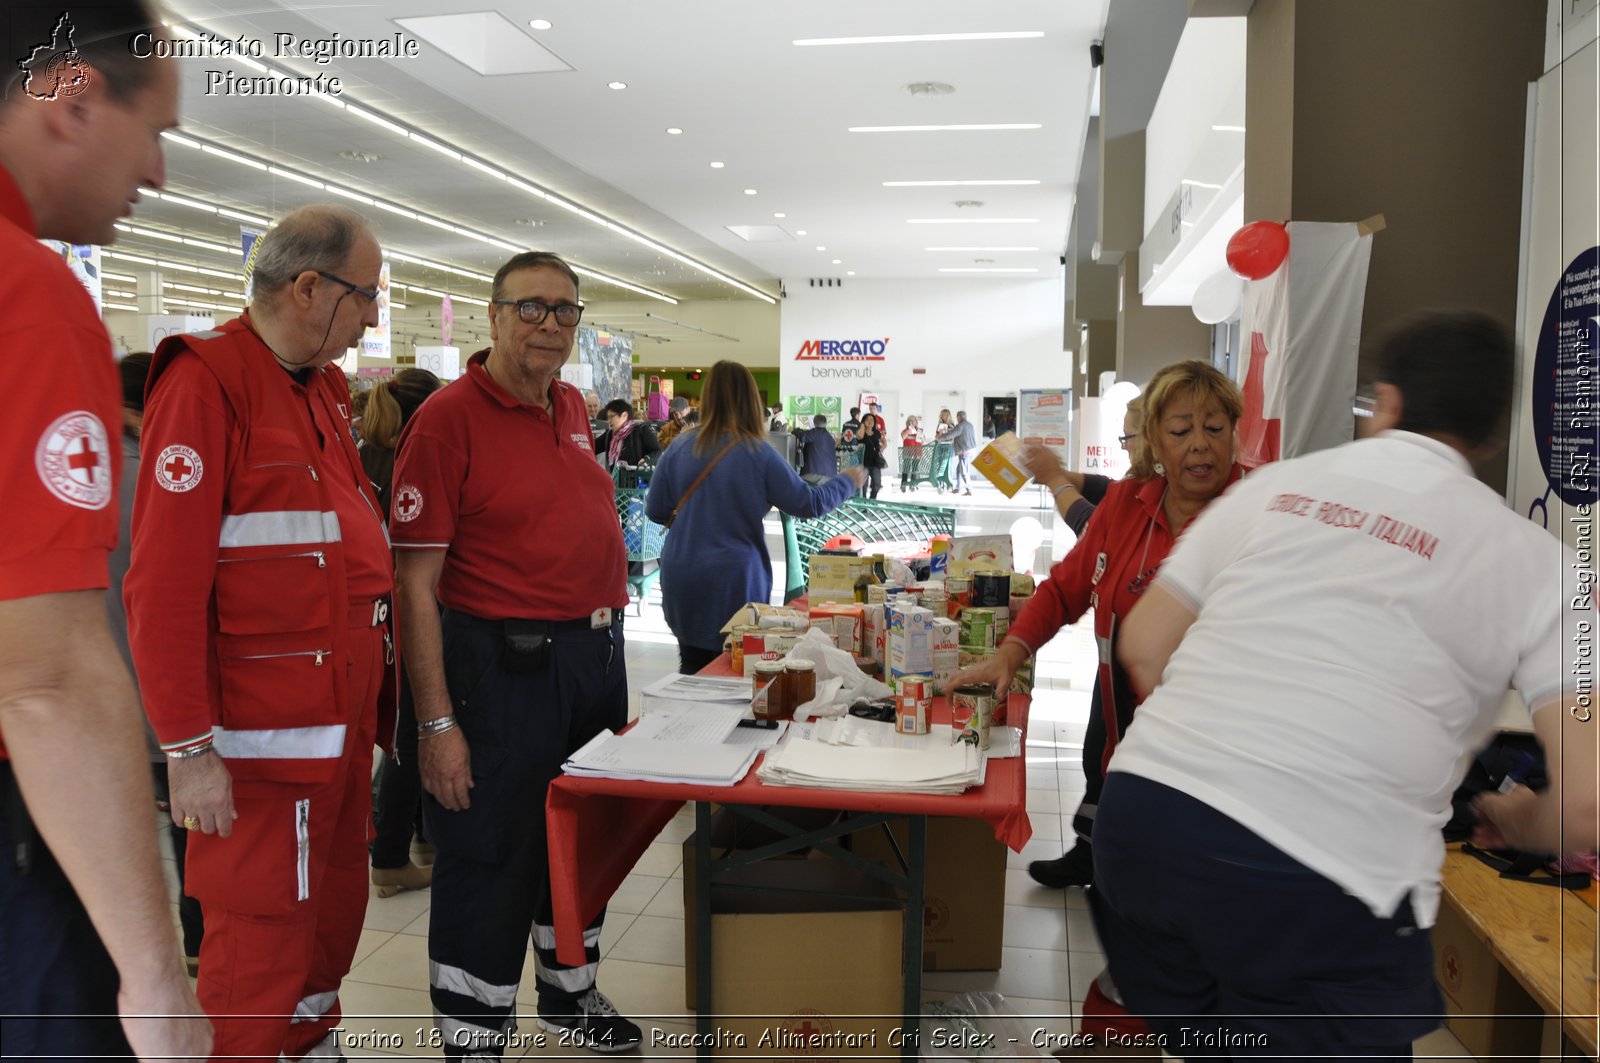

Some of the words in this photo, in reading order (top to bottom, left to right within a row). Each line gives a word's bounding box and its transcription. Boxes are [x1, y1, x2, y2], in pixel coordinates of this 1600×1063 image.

[419, 354, 441, 371] 03
[811, 365, 872, 378] benvenuti
[1086, 458, 1099, 468] LA
[1368, 514, 1440, 560] ITALIANA
